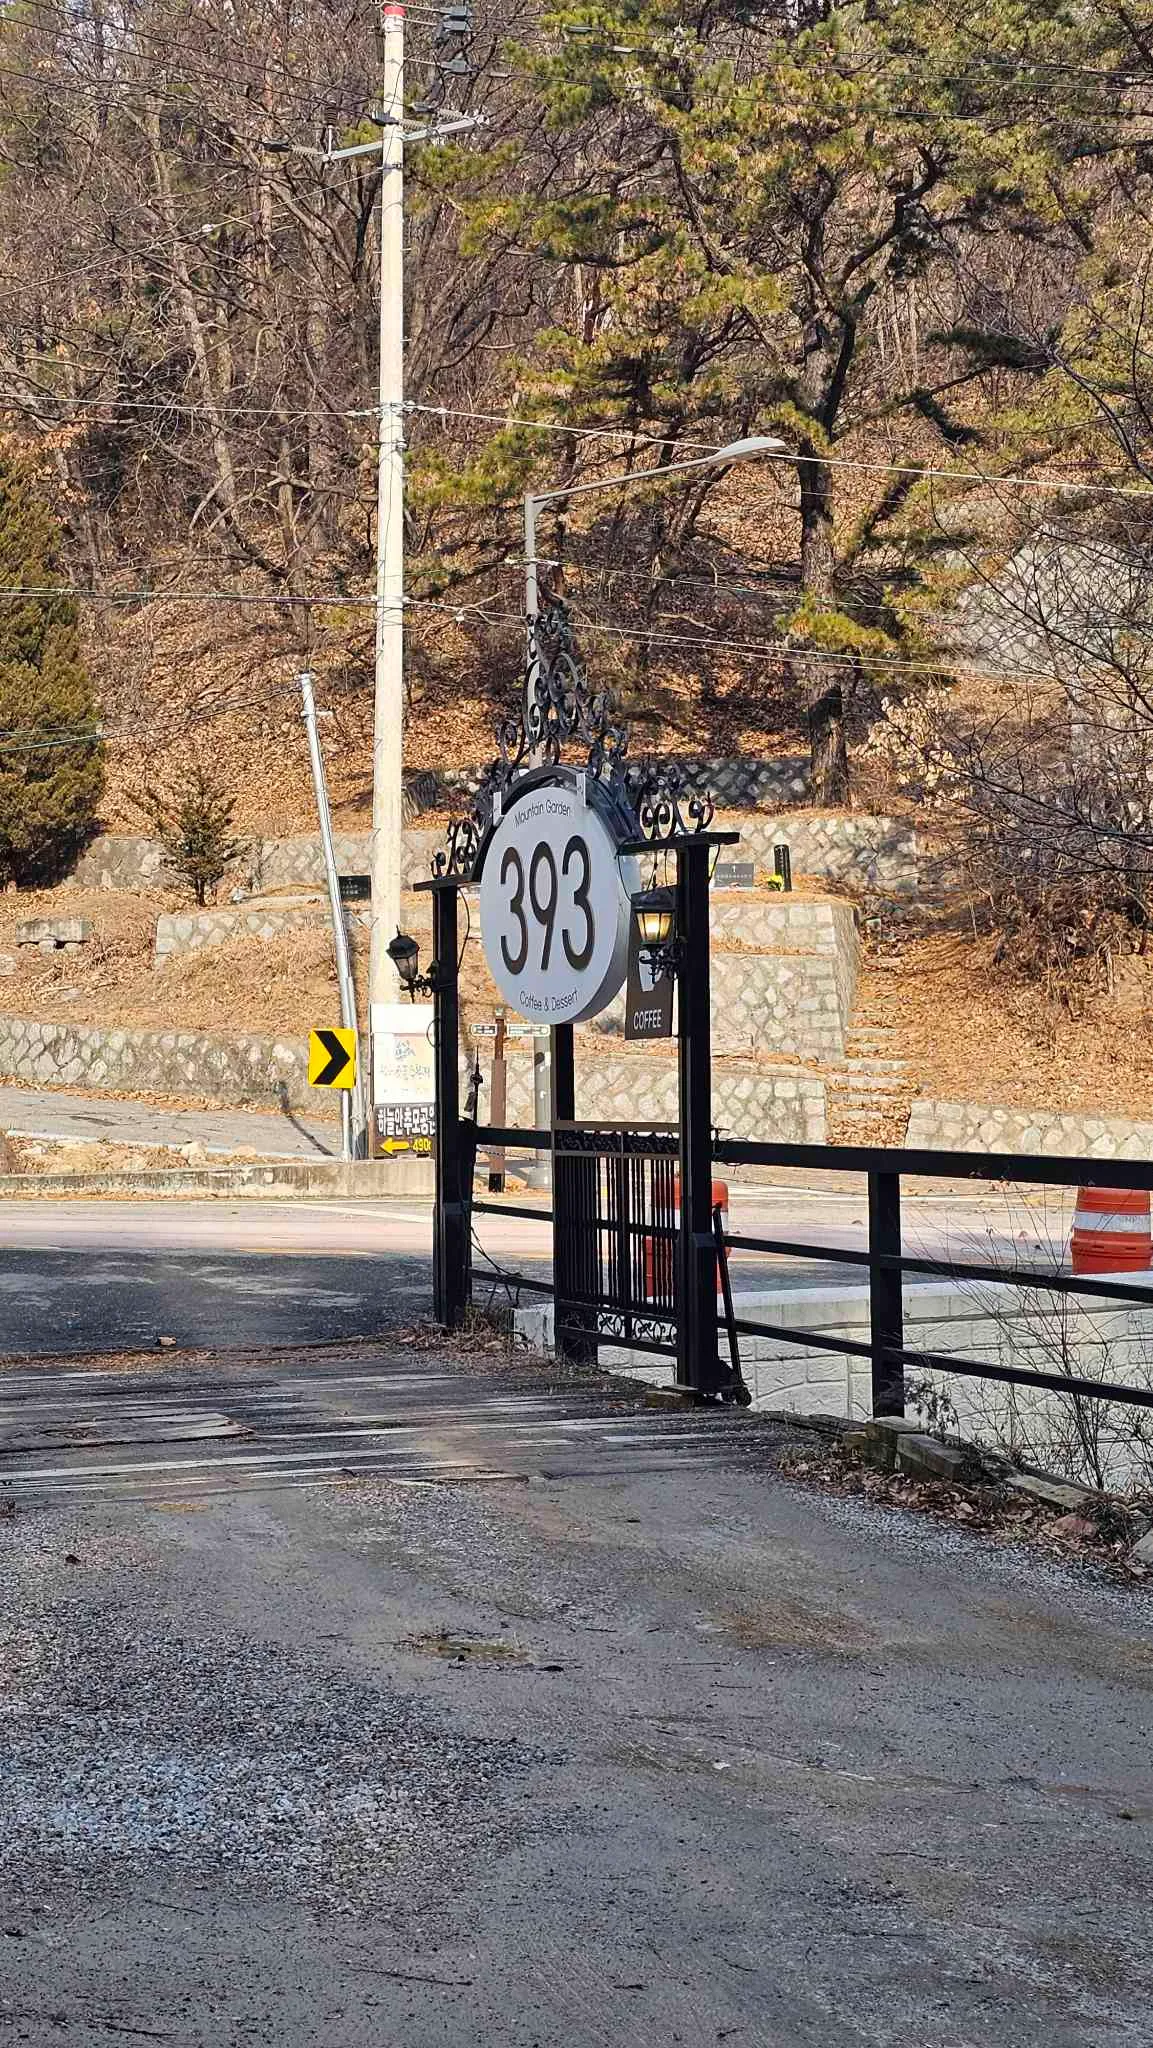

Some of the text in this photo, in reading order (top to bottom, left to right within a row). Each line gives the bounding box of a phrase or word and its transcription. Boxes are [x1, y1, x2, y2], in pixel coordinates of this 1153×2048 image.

[513, 800, 571, 828] Mountain Garden
[500, 835, 595, 975] 393
[520, 987, 578, 1012] Coffee & Dessert
[633, 1008, 662, 1030] COFFEE
